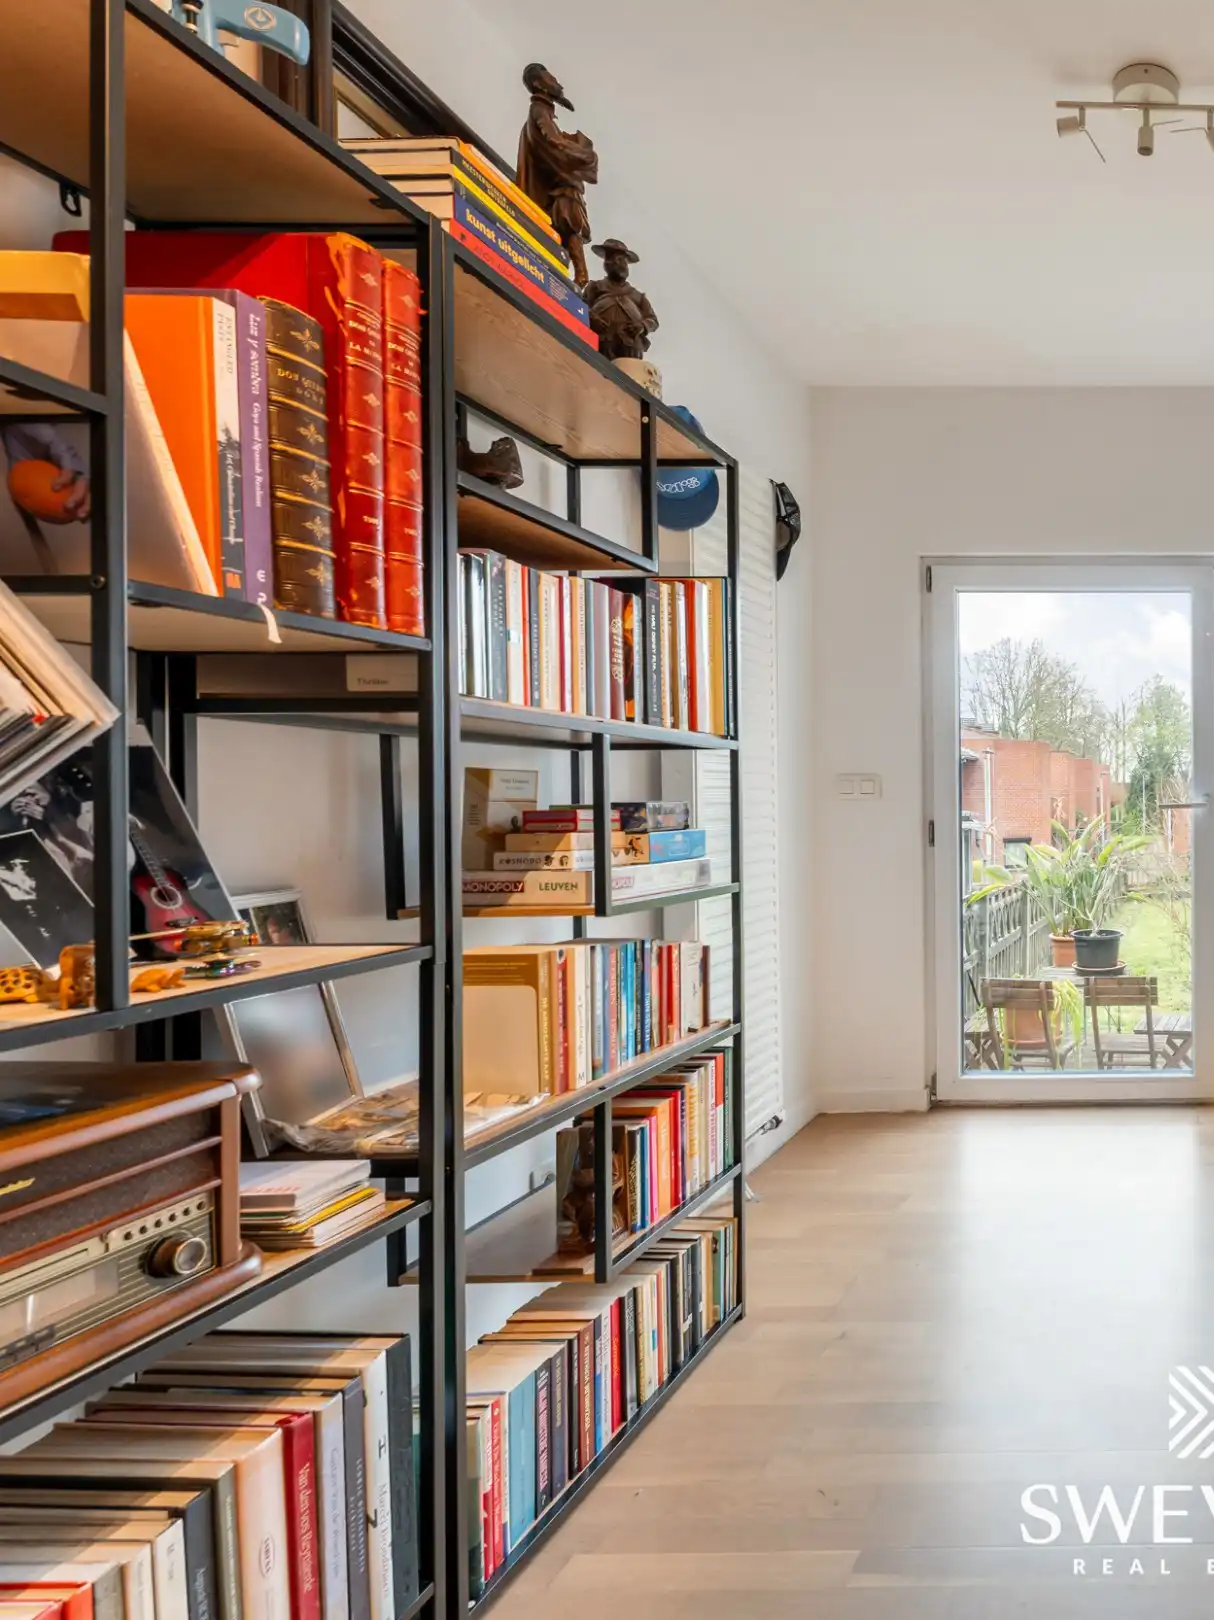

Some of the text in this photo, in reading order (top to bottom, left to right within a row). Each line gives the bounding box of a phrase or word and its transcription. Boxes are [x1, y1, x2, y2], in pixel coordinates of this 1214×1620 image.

[466, 208, 497, 243] kunst
[498, 238, 545, 284] uitgelicht
[277, 368, 299, 381] DON
[462, 881, 525, 893] MONOPOLY
[538, 881, 579, 892] LEUVEN
[298, 1461, 316, 1594] Van den vos Reynaerde
